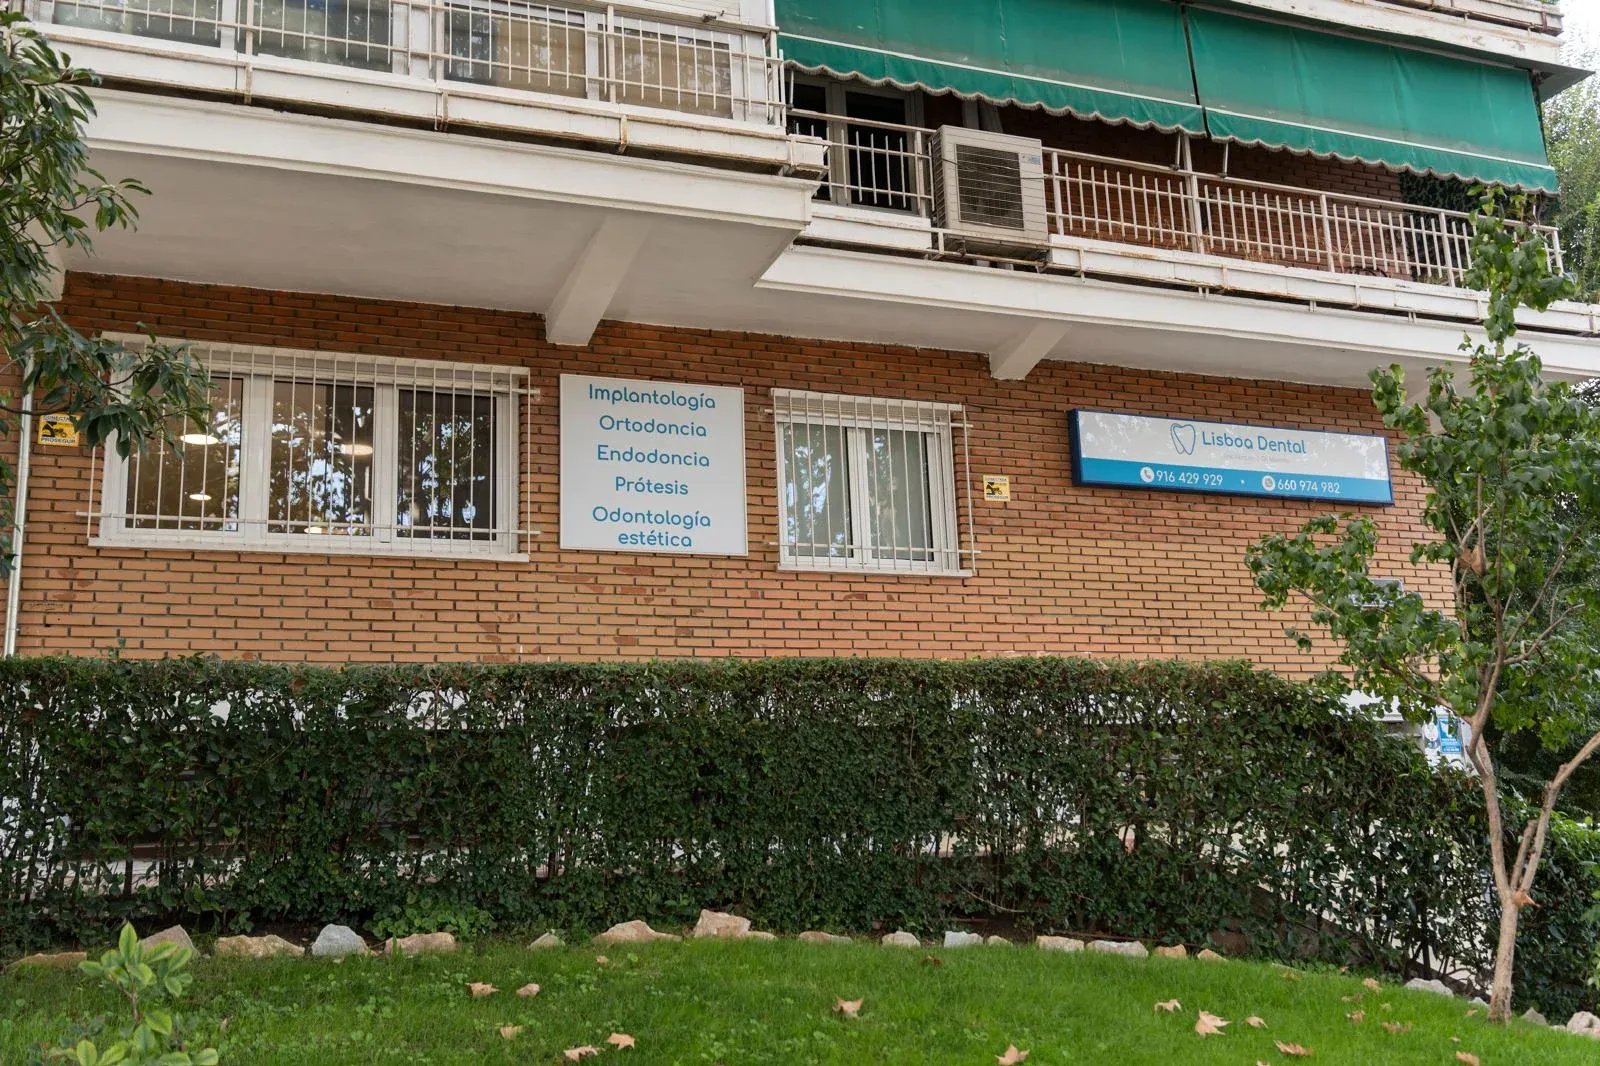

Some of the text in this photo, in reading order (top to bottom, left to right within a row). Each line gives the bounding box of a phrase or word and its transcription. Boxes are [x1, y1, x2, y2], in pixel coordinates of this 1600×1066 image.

[588, 383, 716, 411] Implantología
[599, 415, 707, 437] Ortodoncia
[1202, 431, 1307, 454] Lisboa Dental
[597, 444, 710, 467] Endodoncia
[615, 476, 689, 496] Prótesis
[1156, 470, 1223, 486] 916 429 929
[1277, 479, 1341, 494] 660 974 982
[592, 506, 711, 530] Odontología
[618, 530, 692, 547] estética
